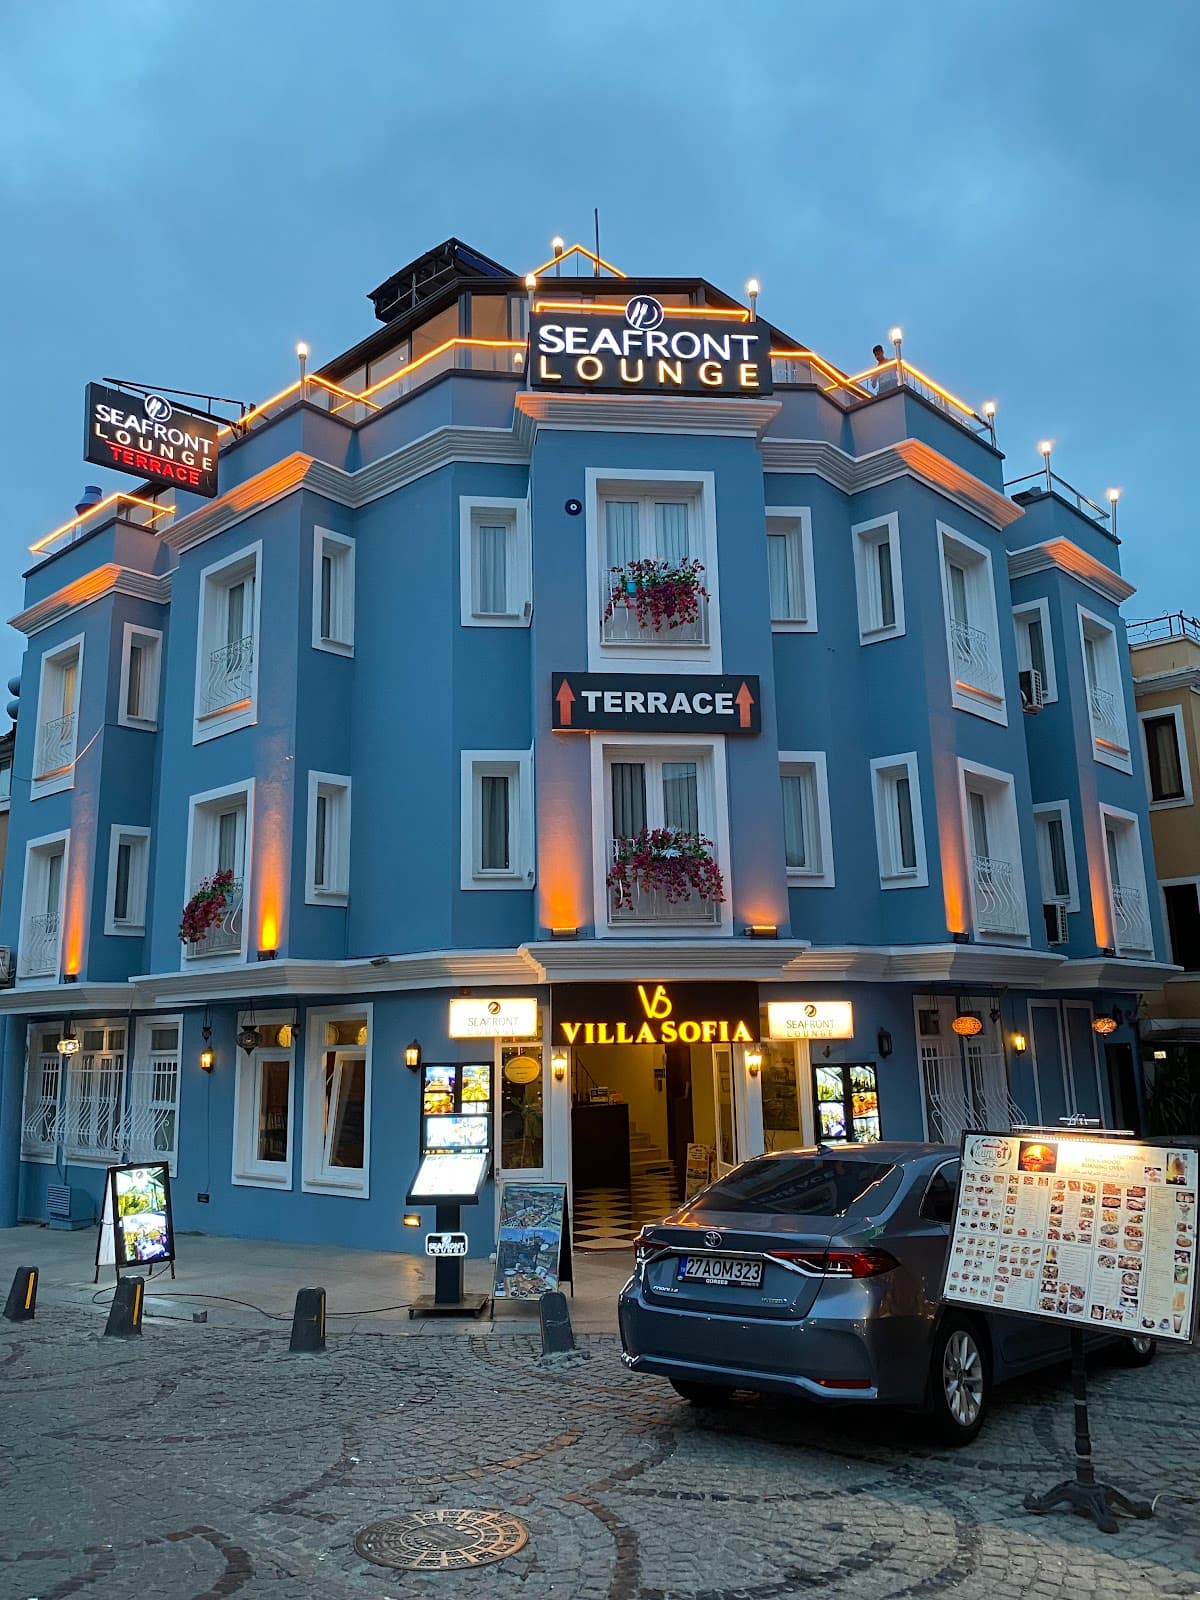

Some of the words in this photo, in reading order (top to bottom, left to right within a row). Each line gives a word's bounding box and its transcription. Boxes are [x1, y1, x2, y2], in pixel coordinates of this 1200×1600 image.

[538, 324, 759, 361] SEAFRONT
[539, 355, 760, 387] LOUNGE
[95, 404, 214, 454] SEAFRONT
[95, 422, 213, 472] LOUNGE
[110, 446, 200, 485] TERRACE
[581, 690, 734, 715] TERRACE
[468, 1017, 519, 1027] SEAFRONT
[560, 1021, 657, 1044] VILLA
[660, 1020, 753, 1043] SOFIA
[786, 1019, 834, 1029] SEAFRONT
[786, 1030, 833, 1038] LOUNGE
